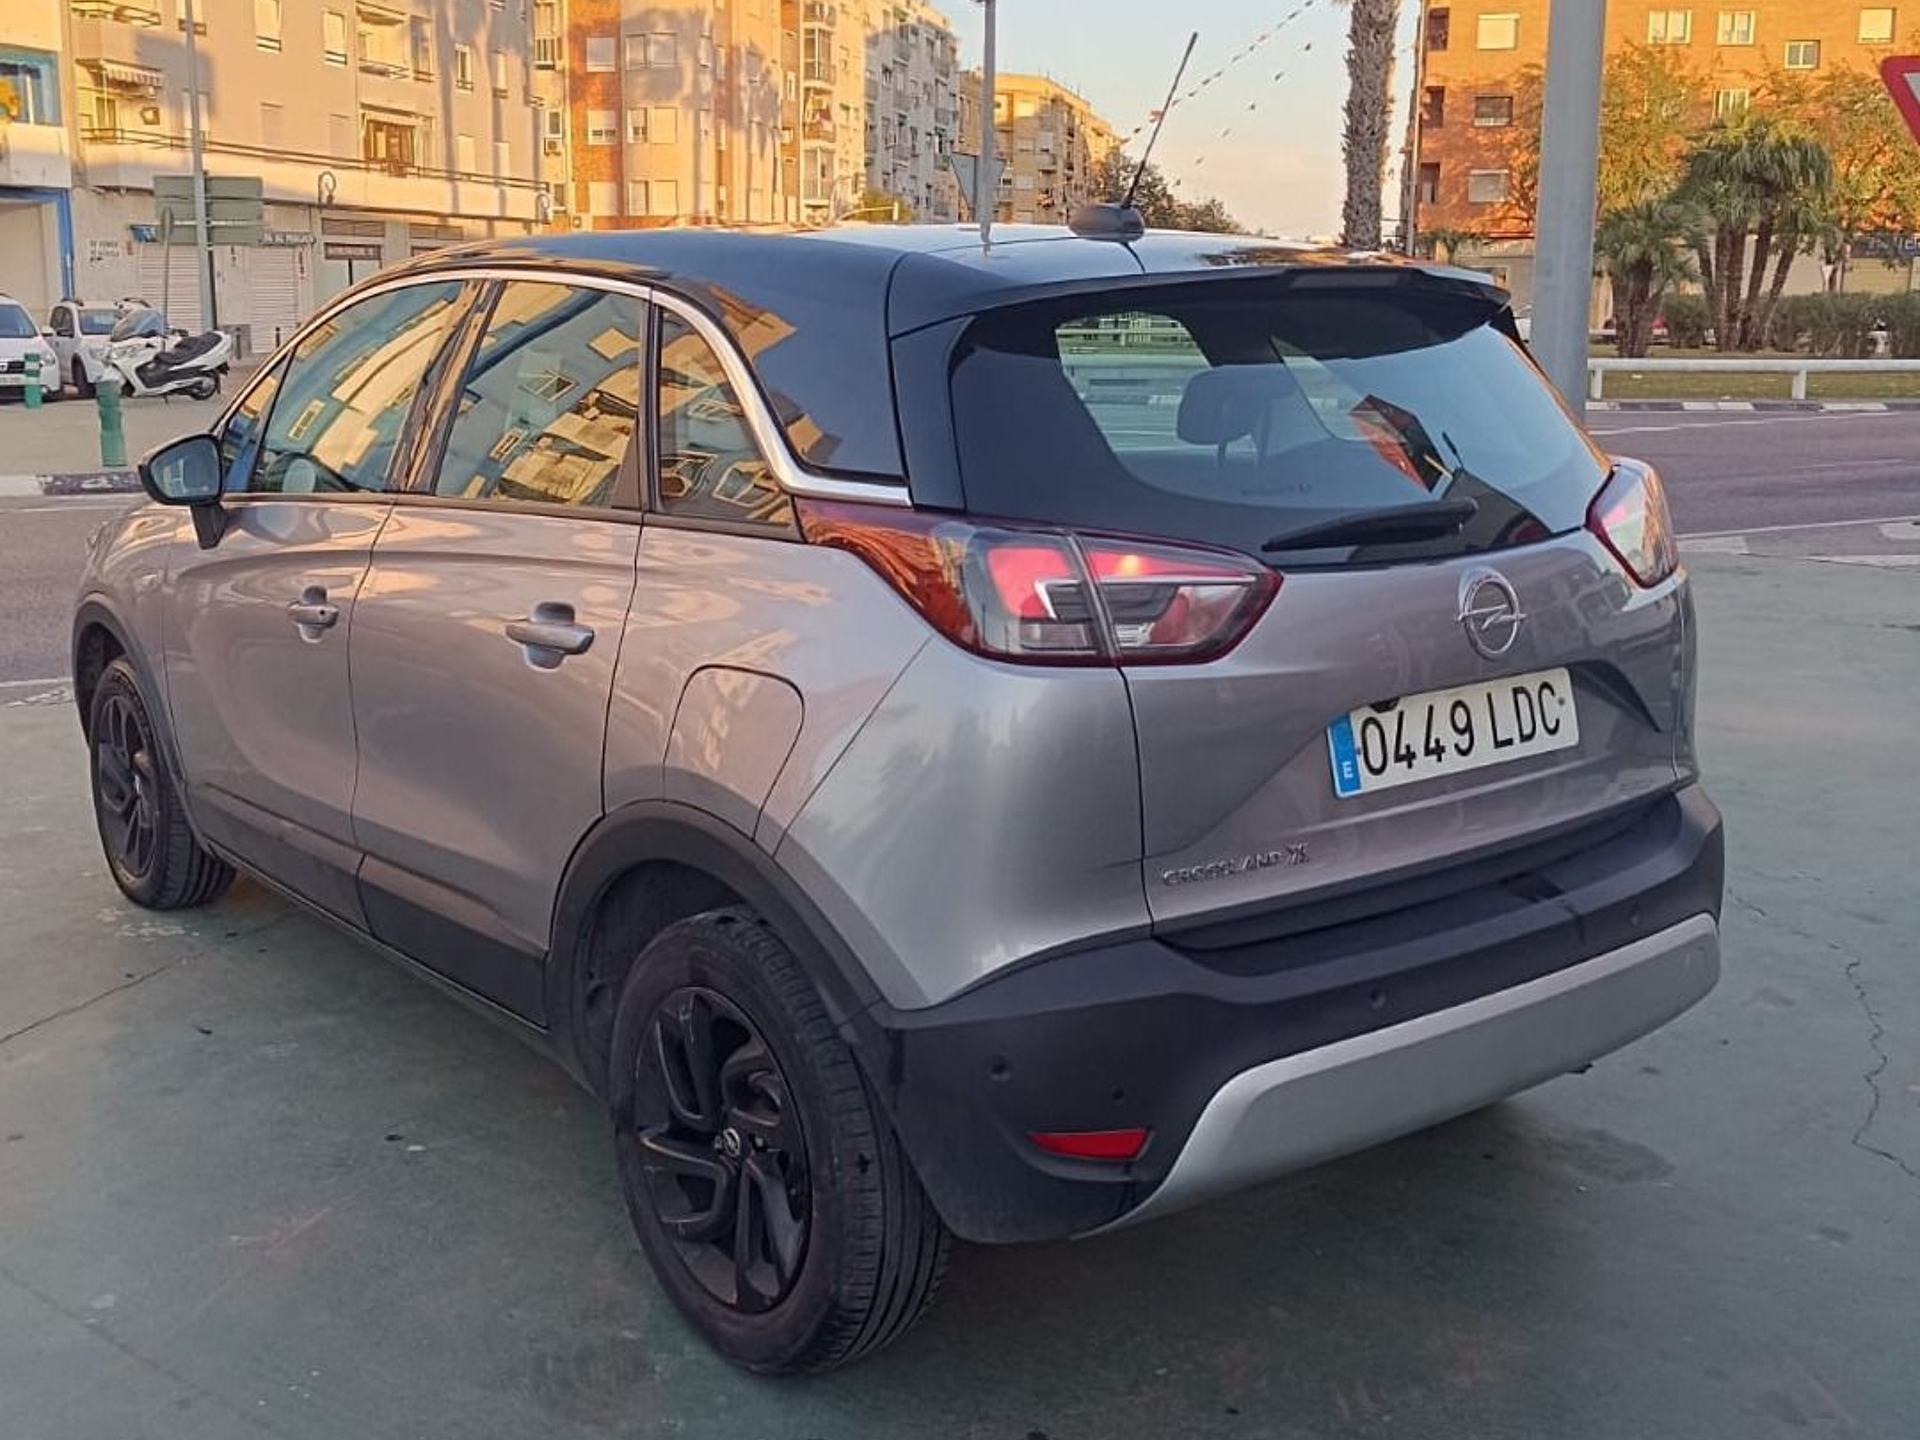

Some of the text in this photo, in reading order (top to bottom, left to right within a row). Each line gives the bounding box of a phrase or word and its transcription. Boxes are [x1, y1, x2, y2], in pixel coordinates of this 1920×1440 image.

[1342, 681, 1561, 779] E 0449 LDC
[1163, 851, 1283, 886] CROSSLAND
